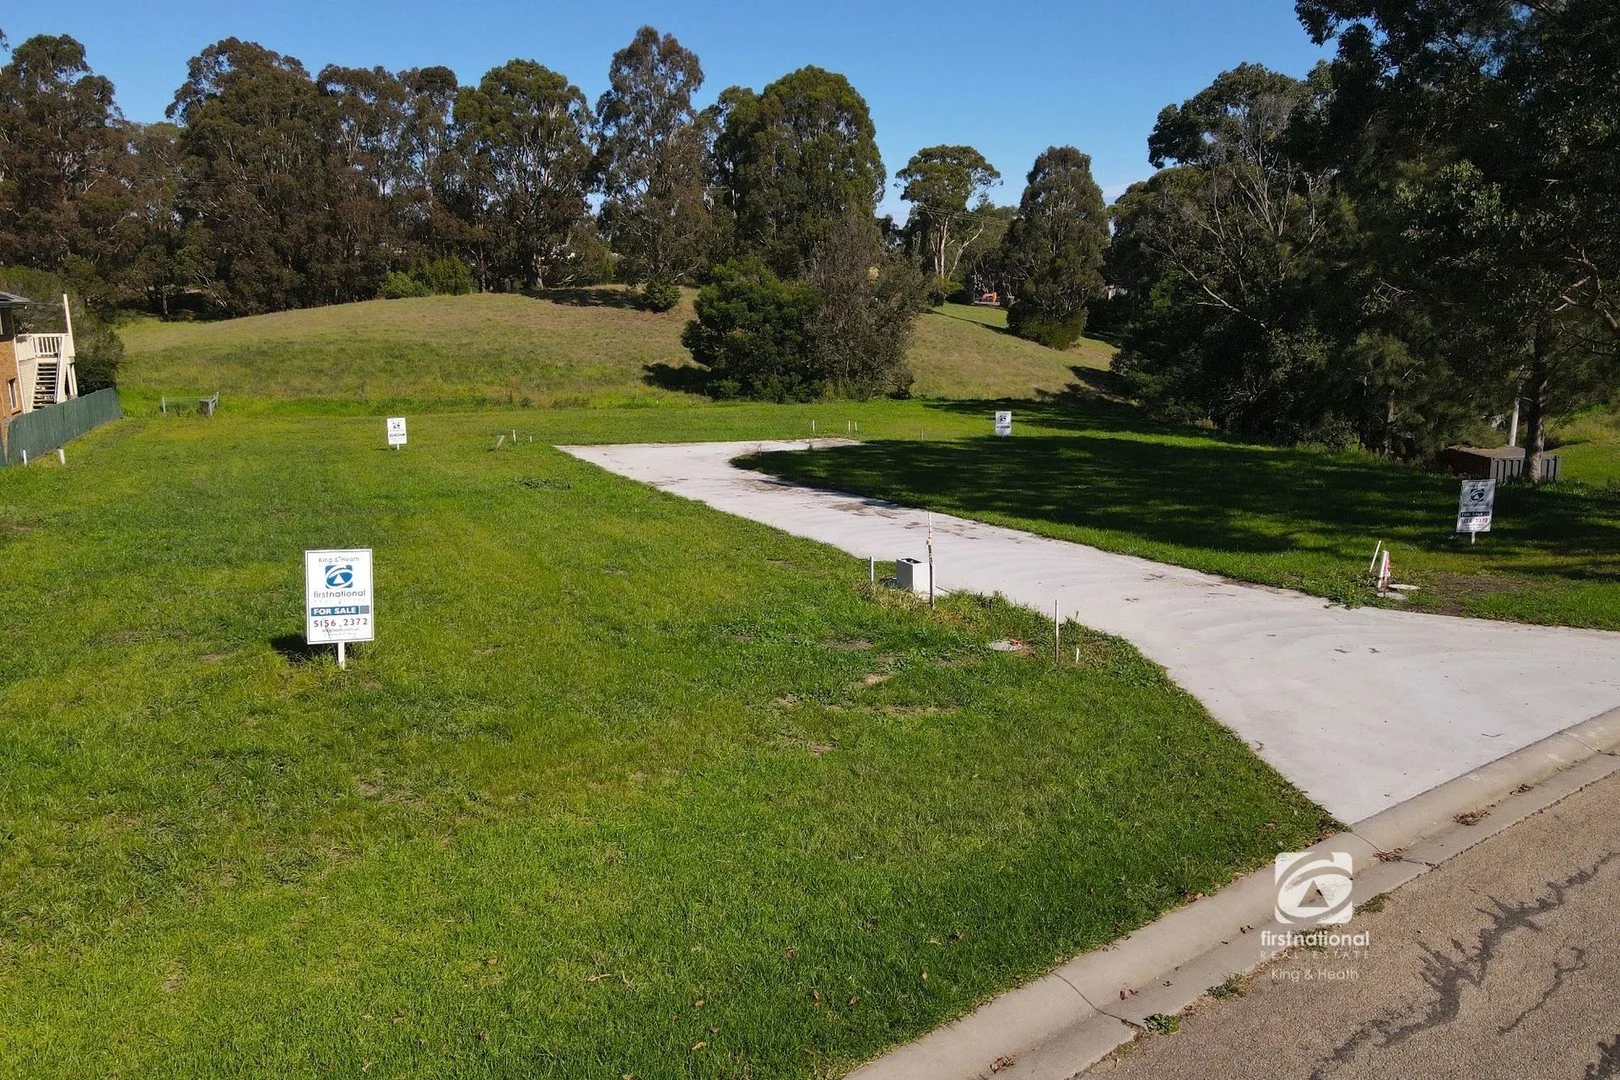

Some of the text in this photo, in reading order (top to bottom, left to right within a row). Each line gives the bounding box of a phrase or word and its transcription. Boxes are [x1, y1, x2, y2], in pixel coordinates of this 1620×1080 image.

[313, 590, 366, 598] firstnational
[313, 606, 357, 616] FOR SALE
[313, 617, 368, 628] 5156 2372
